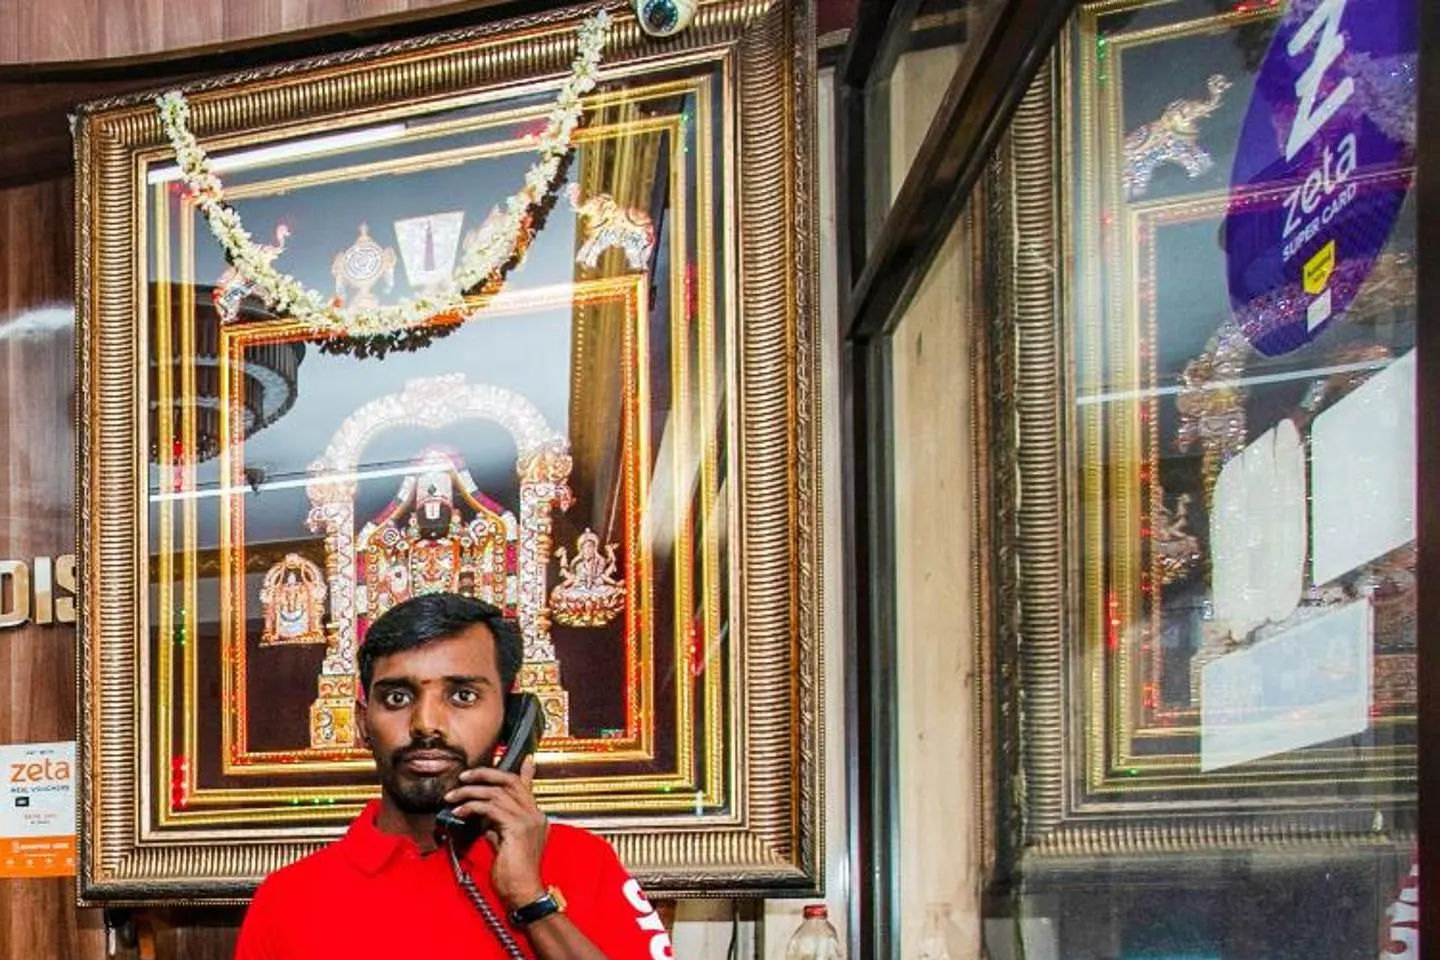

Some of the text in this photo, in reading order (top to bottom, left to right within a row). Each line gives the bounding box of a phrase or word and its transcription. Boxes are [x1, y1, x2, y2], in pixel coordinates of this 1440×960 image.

[1282, 132, 1357, 239] zeta
[1282, 181, 1357, 262] SUPER CARD
[10, 758, 70, 783] zeta
